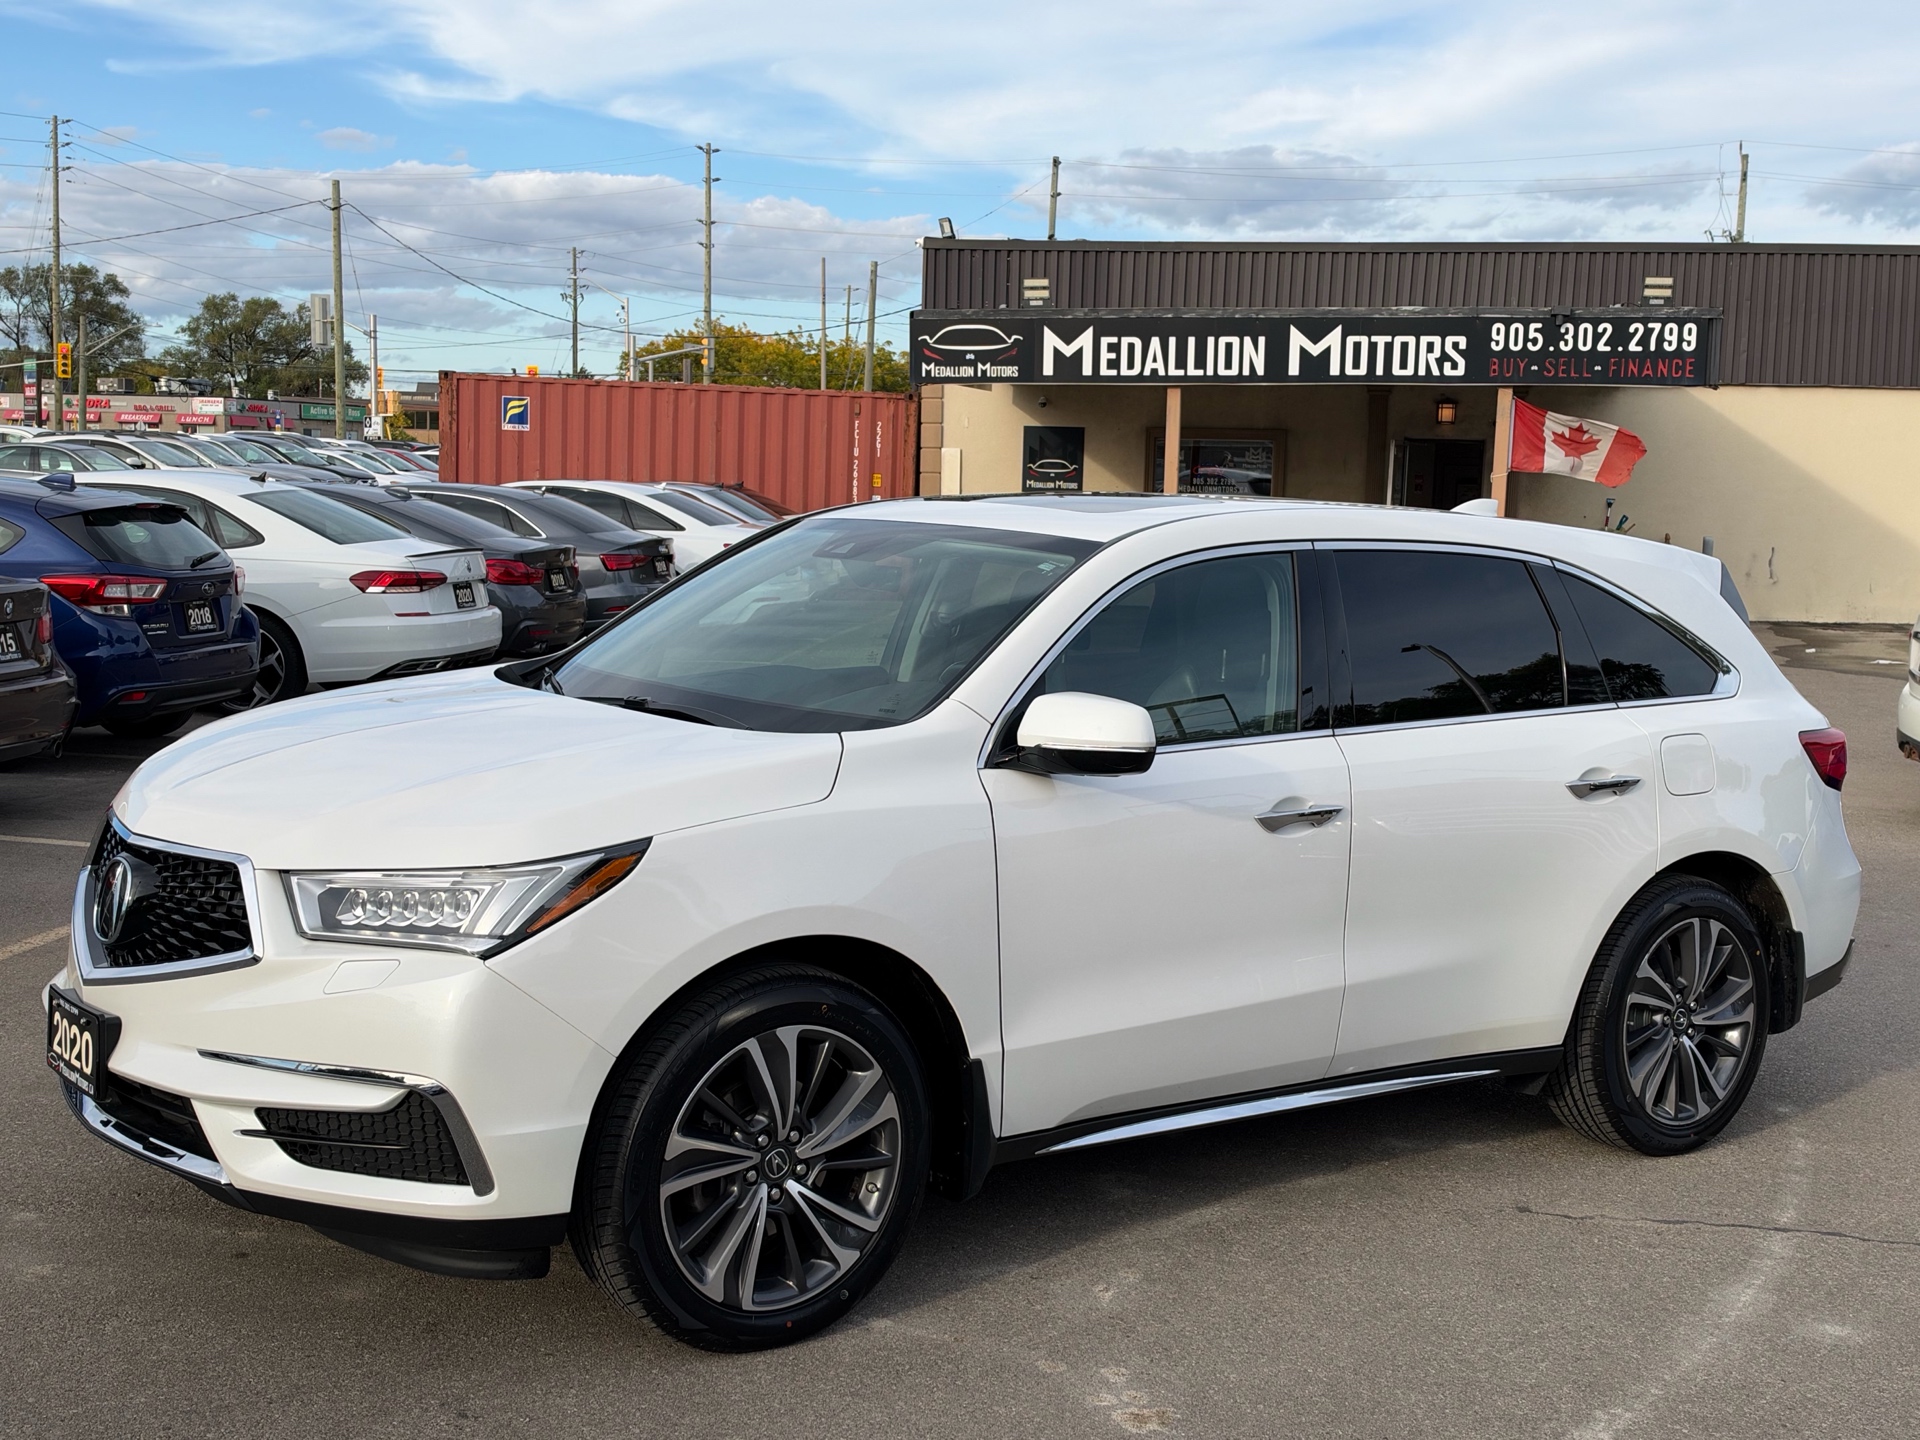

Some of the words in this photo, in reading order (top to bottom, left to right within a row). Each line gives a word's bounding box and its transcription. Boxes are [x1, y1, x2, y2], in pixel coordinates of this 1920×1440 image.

[1490, 322, 1698, 352] 905.302.2799
[1042, 324, 1267, 377] MEDALLION
[1287, 323, 1468, 377] MOTORS
[921, 361, 974, 378] MEDALLION
[977, 361, 1019, 378] MOTORS
[1489, 357, 1529, 378] BUY
[1543, 357, 1592, 378] SELL
[1608, 358, 1696, 379] FINANCE
[310, 406, 328, 415] Active
[1026, 479, 1054, 489] MEDALLION
[1055, 480, 1079, 490] MOTORS
[188, 606, 212, 626] 2018
[52, 1010, 94, 1076] 2020
